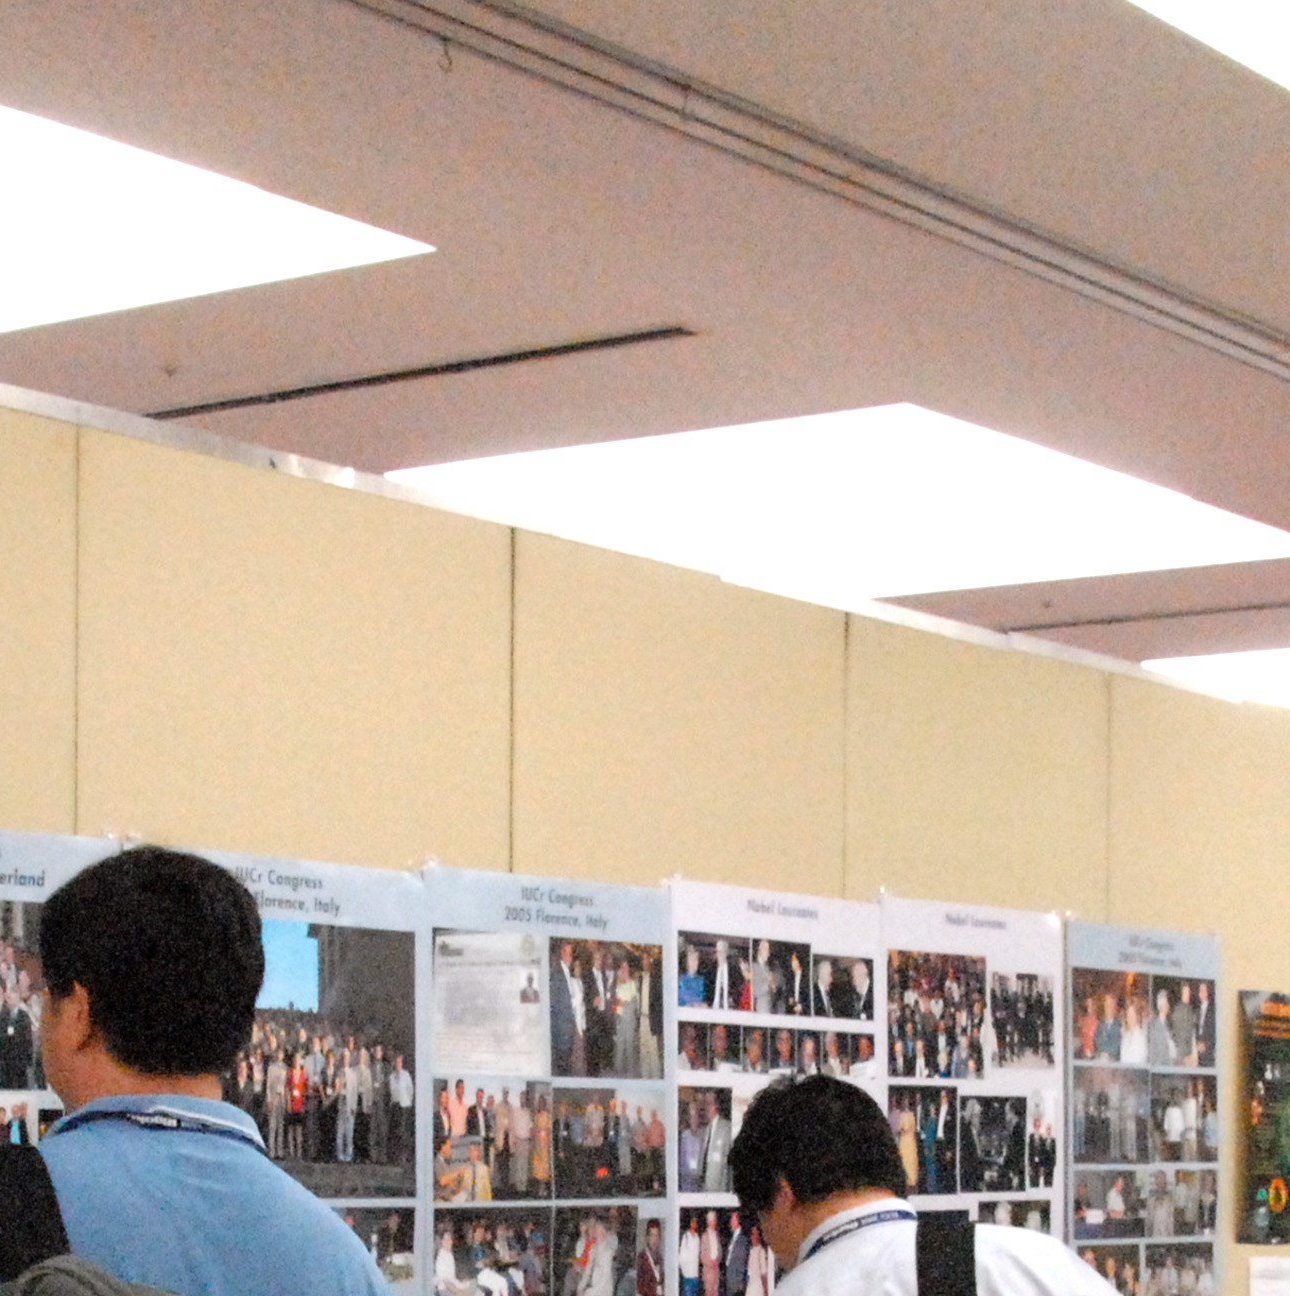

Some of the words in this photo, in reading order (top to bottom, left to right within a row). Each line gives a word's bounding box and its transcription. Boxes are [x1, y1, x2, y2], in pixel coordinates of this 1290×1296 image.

[267, 868, 324, 892] Congress
[314, 896, 341, 918] Italy
[548, 888, 594, 909] Congress
